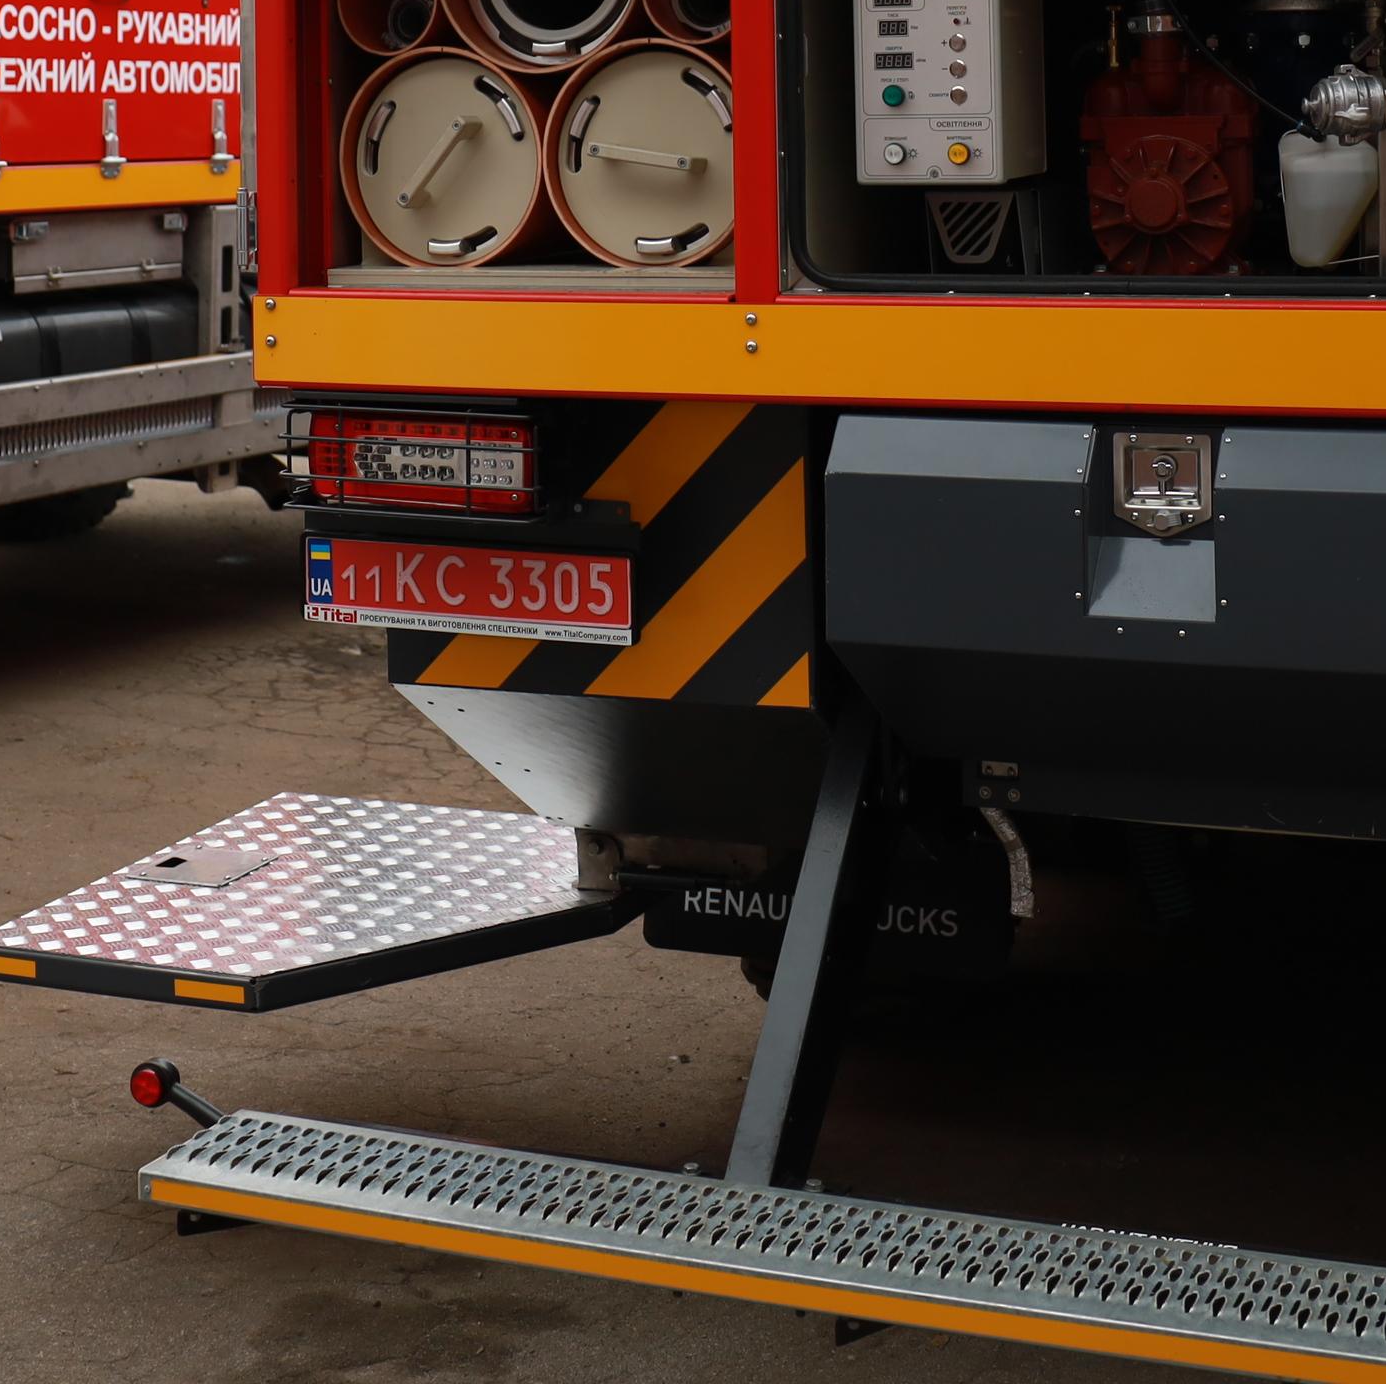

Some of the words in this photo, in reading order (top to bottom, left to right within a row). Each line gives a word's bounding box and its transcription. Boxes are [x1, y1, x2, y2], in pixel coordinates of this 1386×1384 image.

[100, 59, 242, 95] АВТОМОБІЛ
[936, 120, 983, 128] ОСВІТЛЕННЯ
[310, 577, 332, 597] UA
[488, 557, 614, 617] 3305
[319, 607, 357, 623] Tital
[359, 613, 416, 626] ПРОЕКТУВАННЯ
[417, 619, 427, 628] ТА
[428, 620, 487, 633] ВИГОТОВЛЕННЯ
[487, 624, 539, 636] СПЕЦТЕХНІКИ
[544, 629, 628, 642] www.TitalCompany.com
